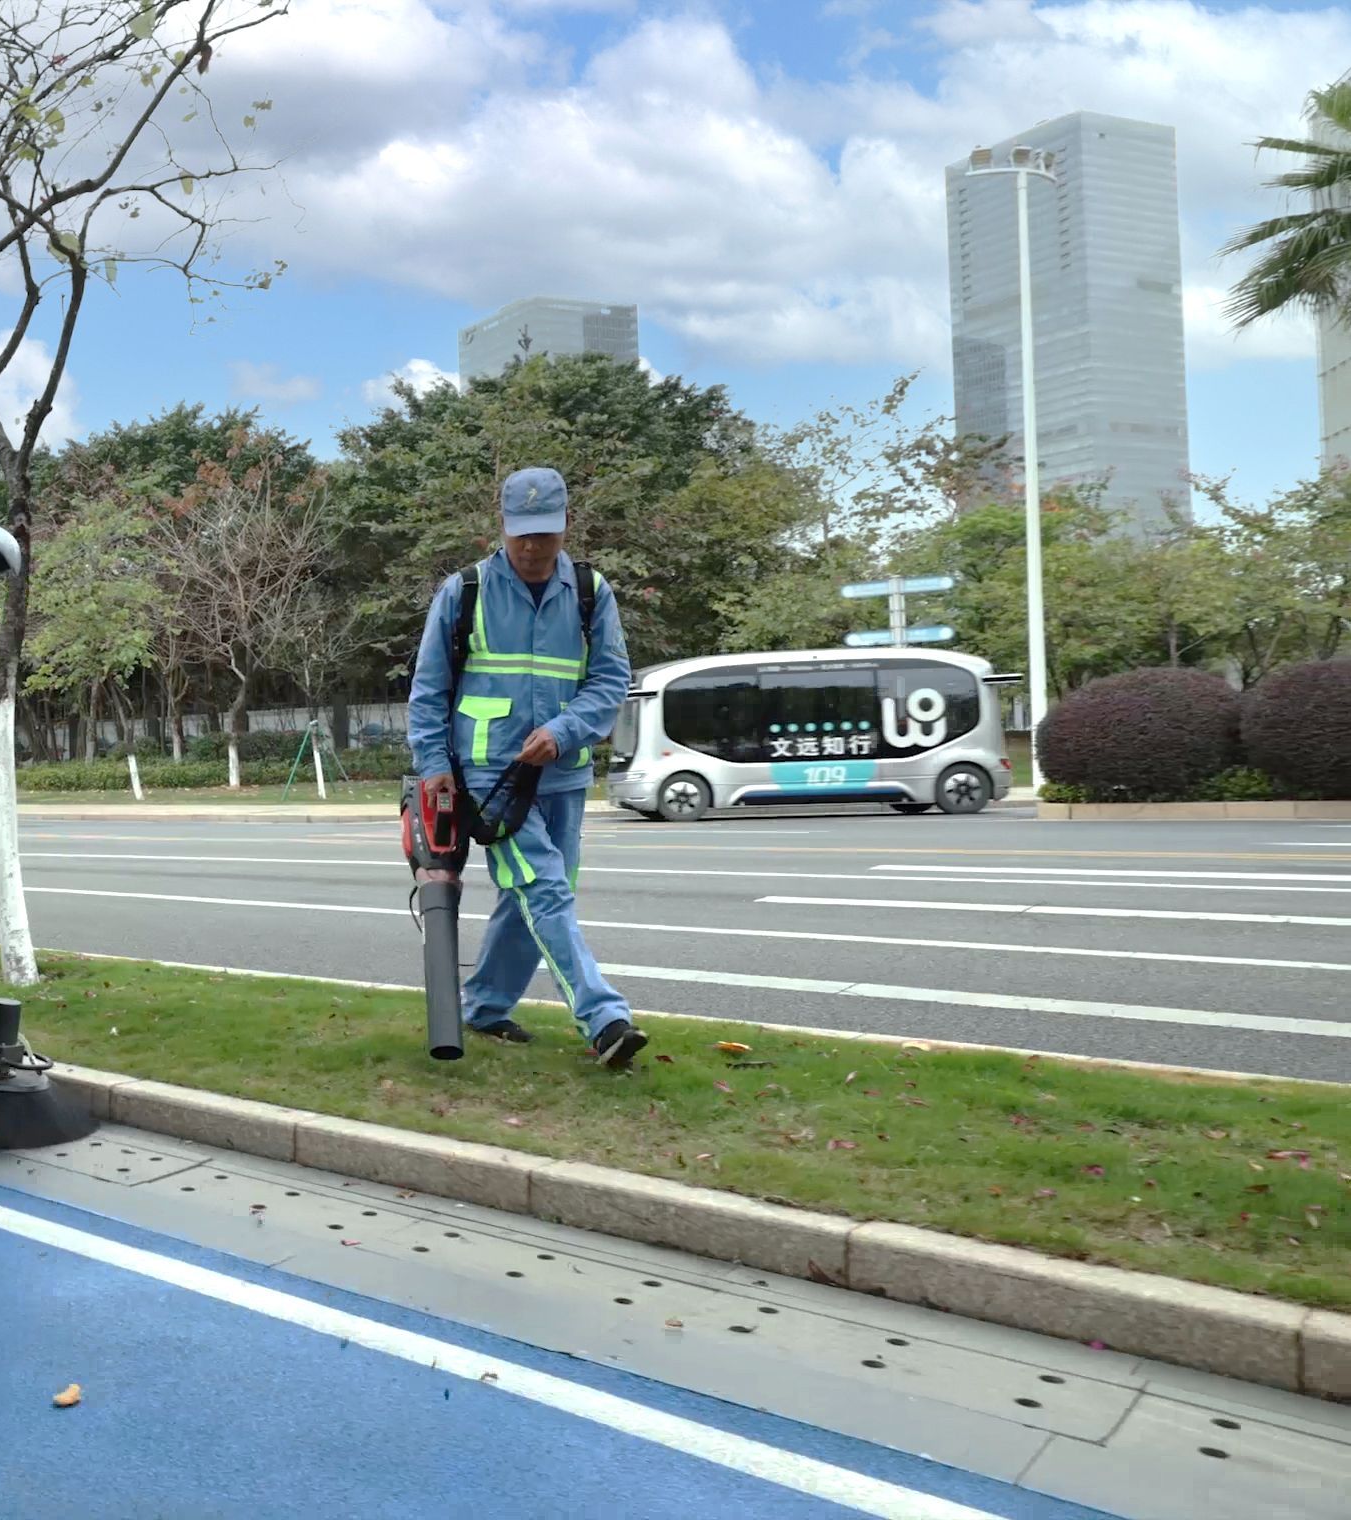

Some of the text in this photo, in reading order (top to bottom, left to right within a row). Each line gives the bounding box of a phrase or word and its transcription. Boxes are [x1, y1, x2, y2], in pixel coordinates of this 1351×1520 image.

[770, 736, 872, 758] 文远知行
[804, 766, 847, 786] 109
